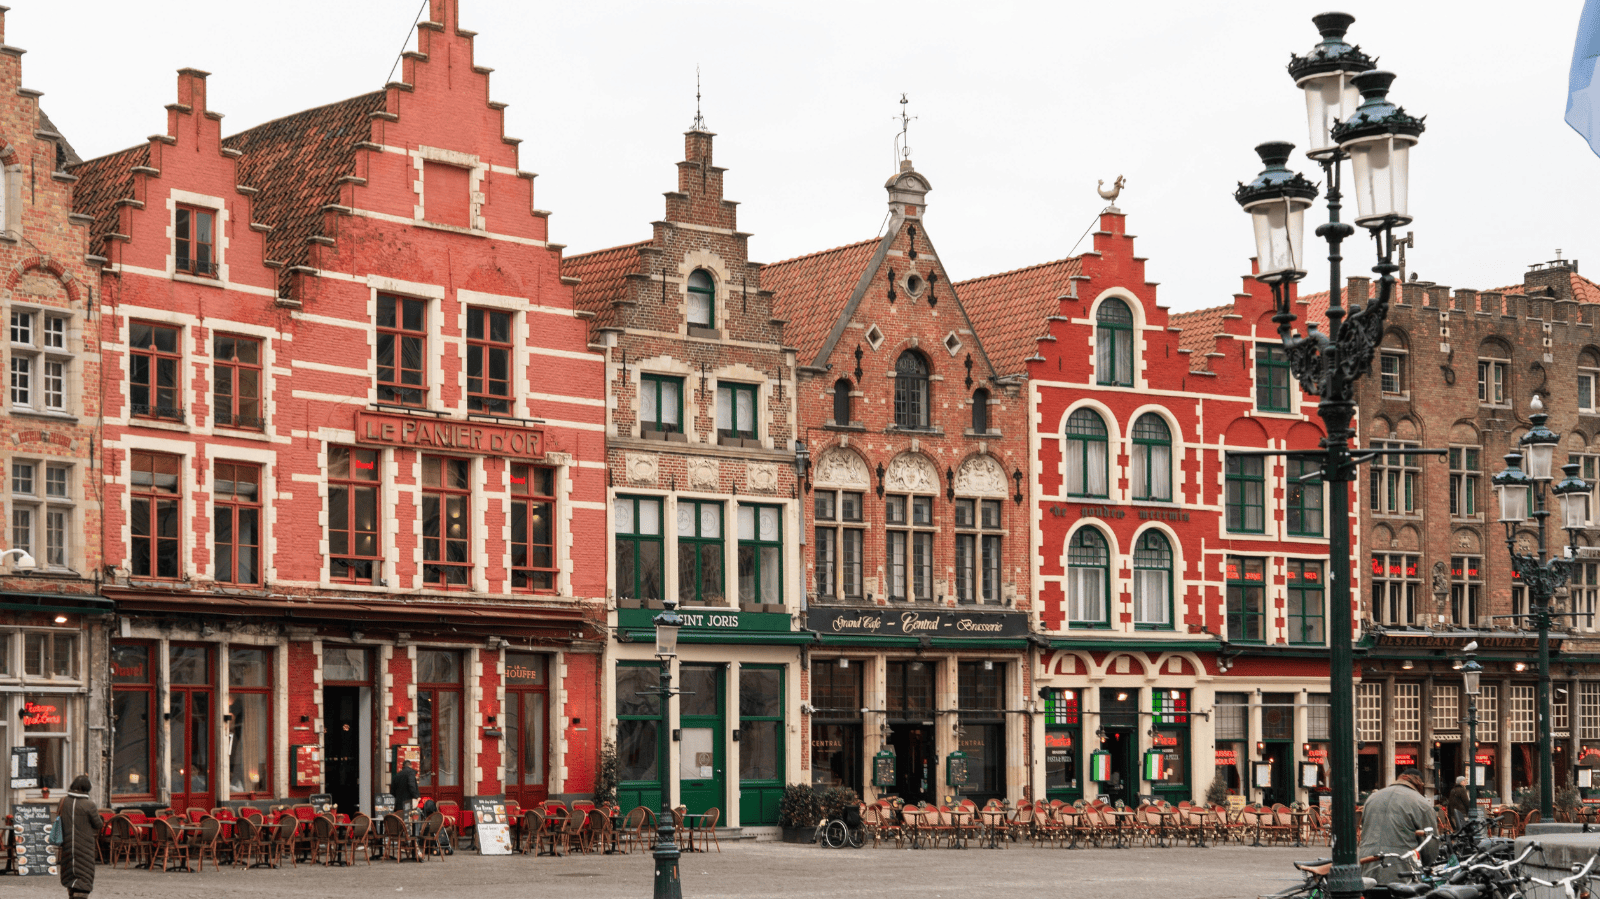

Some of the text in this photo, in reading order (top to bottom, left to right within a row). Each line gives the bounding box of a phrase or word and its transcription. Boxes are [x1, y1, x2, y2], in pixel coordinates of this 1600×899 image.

[366, 420, 539, 455] LE PANIER D'OR
[706, 615, 738, 627] JORIS
[832, 615, 862, 631] Grand
[901, 611, 940, 633] Central
[956, 618, 1003, 632] Brasserie
[1379, 636, 1455, 646] RESTAURANT
